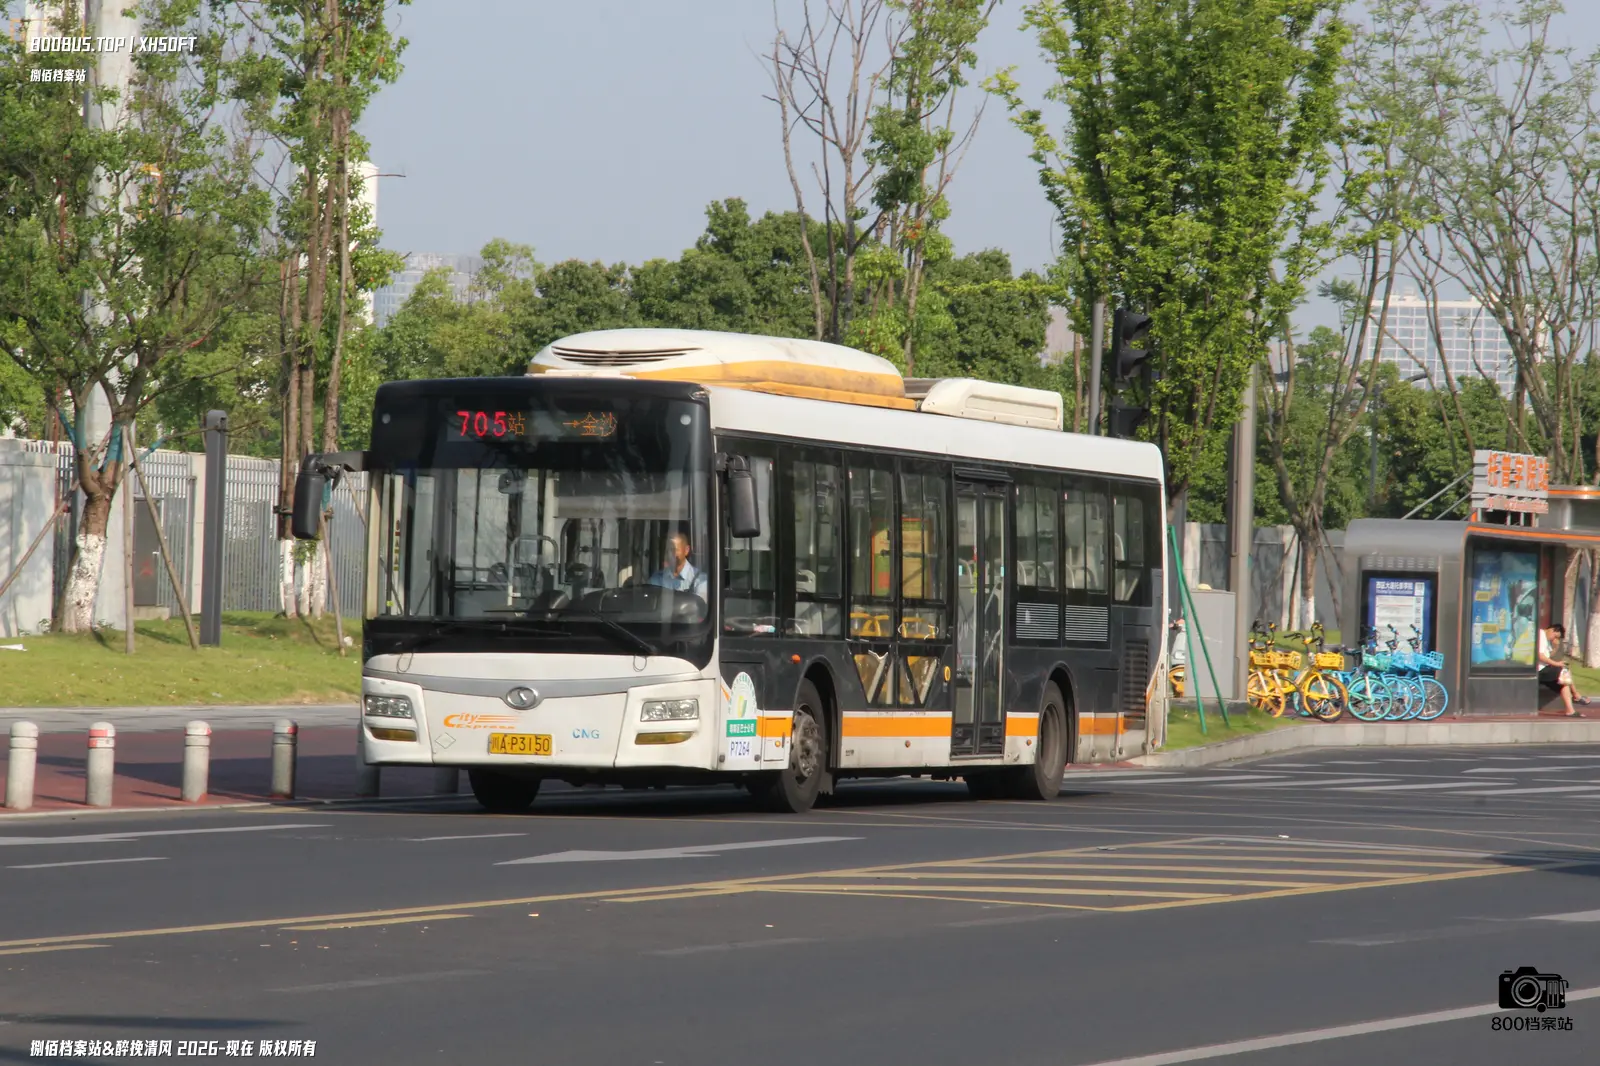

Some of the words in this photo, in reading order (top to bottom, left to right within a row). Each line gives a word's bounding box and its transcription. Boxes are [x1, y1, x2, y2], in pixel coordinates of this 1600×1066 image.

[457, 411, 507, 437] 705
[508, 411, 526, 435] 站
[580, 411, 618, 437] 金沙
[572, 728, 600, 739] CNG
[730, 741, 750, 757] P7264
